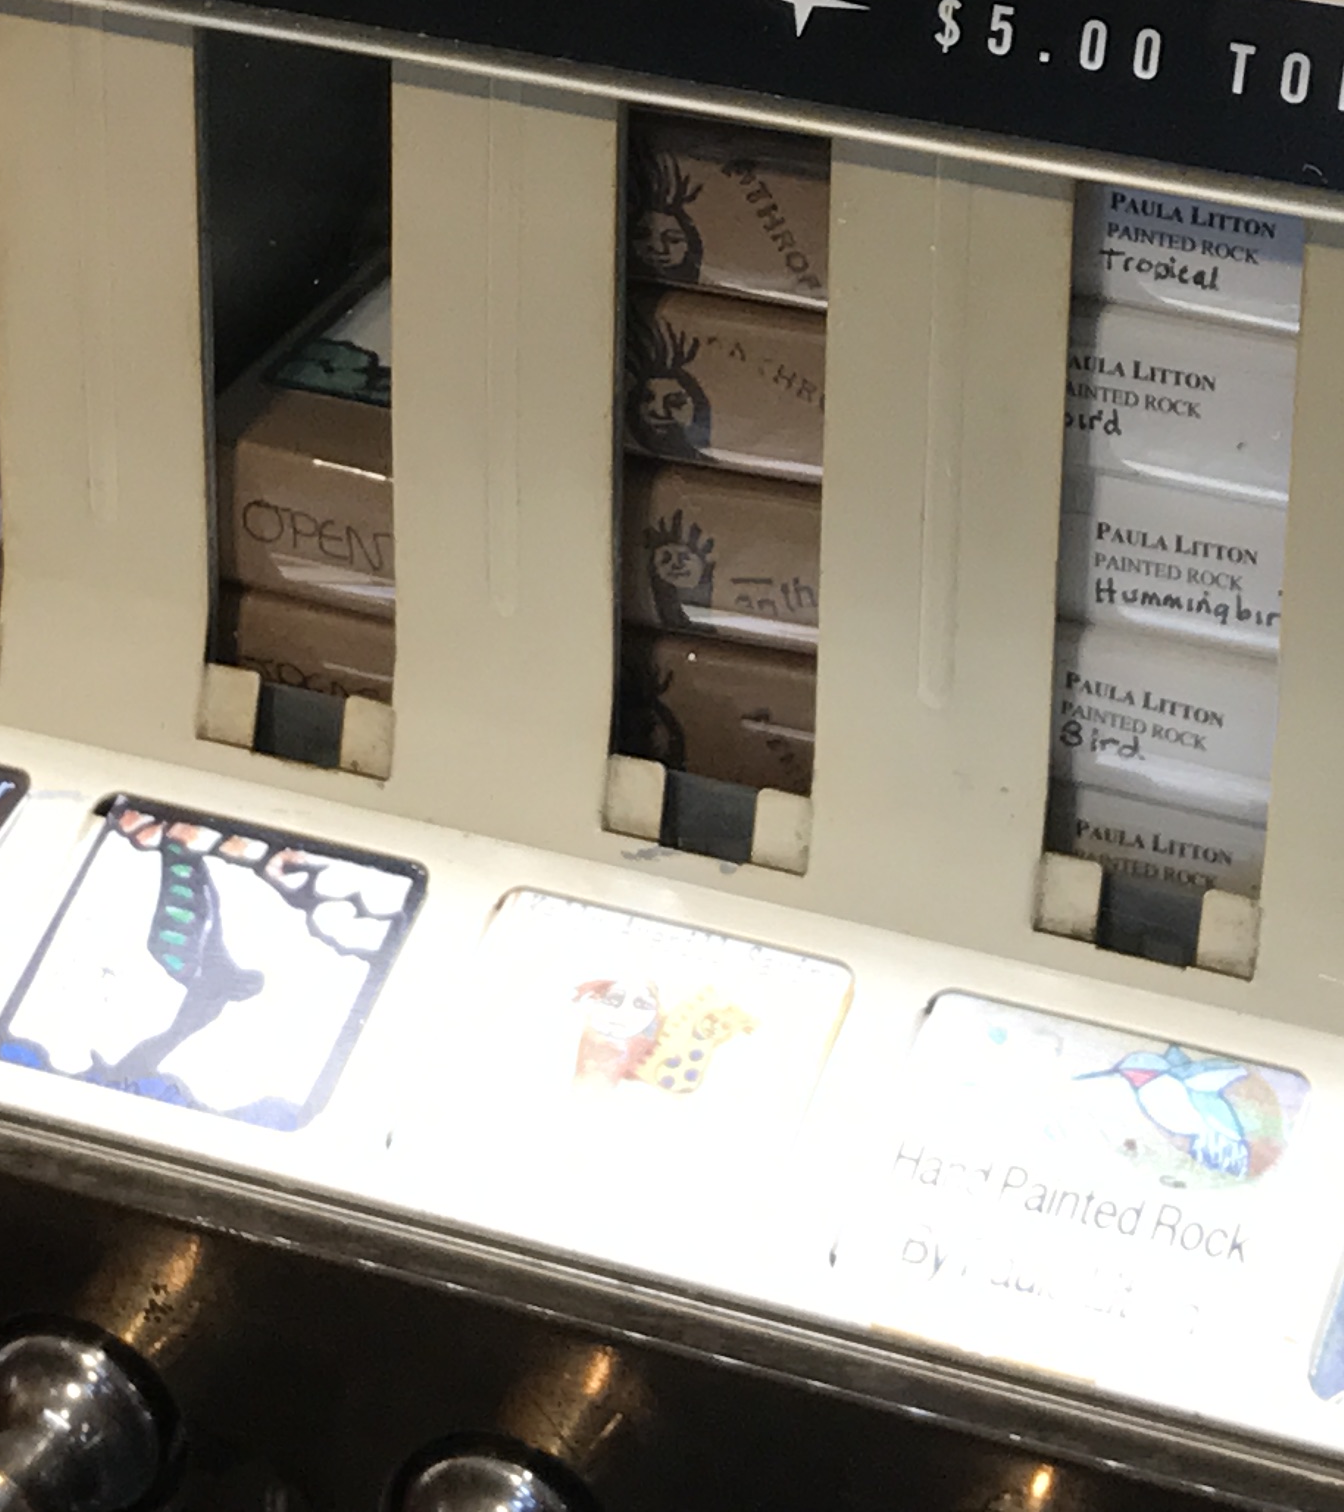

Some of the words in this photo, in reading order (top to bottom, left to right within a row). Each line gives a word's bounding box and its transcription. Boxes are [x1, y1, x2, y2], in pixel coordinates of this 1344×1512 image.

[1109, 190, 1184, 225] PAULA
[1189, 205, 1277, 240] LITTON
[1105, 221, 1197, 253] PAINTED
[1201, 239, 1260, 266] ROCK
[1132, 359, 1217, 393] LITTON
[1144, 393, 1202, 420] ROCK
[242, 498, 392, 572] OPEN
[1095, 520, 1168, 552] PAULA
[1174, 534, 1259, 566] LITTON
[1093, 551, 1182, 582] PAINTED
[1186, 567, 1244, 592] ROCK
[1065, 670, 1137, 707] PAULA
[1142, 690, 1226, 729] LITTON
[1060, 699, 1148, 735] PAINTED
[1151, 723, 1209, 752] ROCK
[1151, 833, 1234, 867] LITTON
[997, 1164, 1146, 1237] Painted
[1150, 1202, 1251, 1264] Rock
